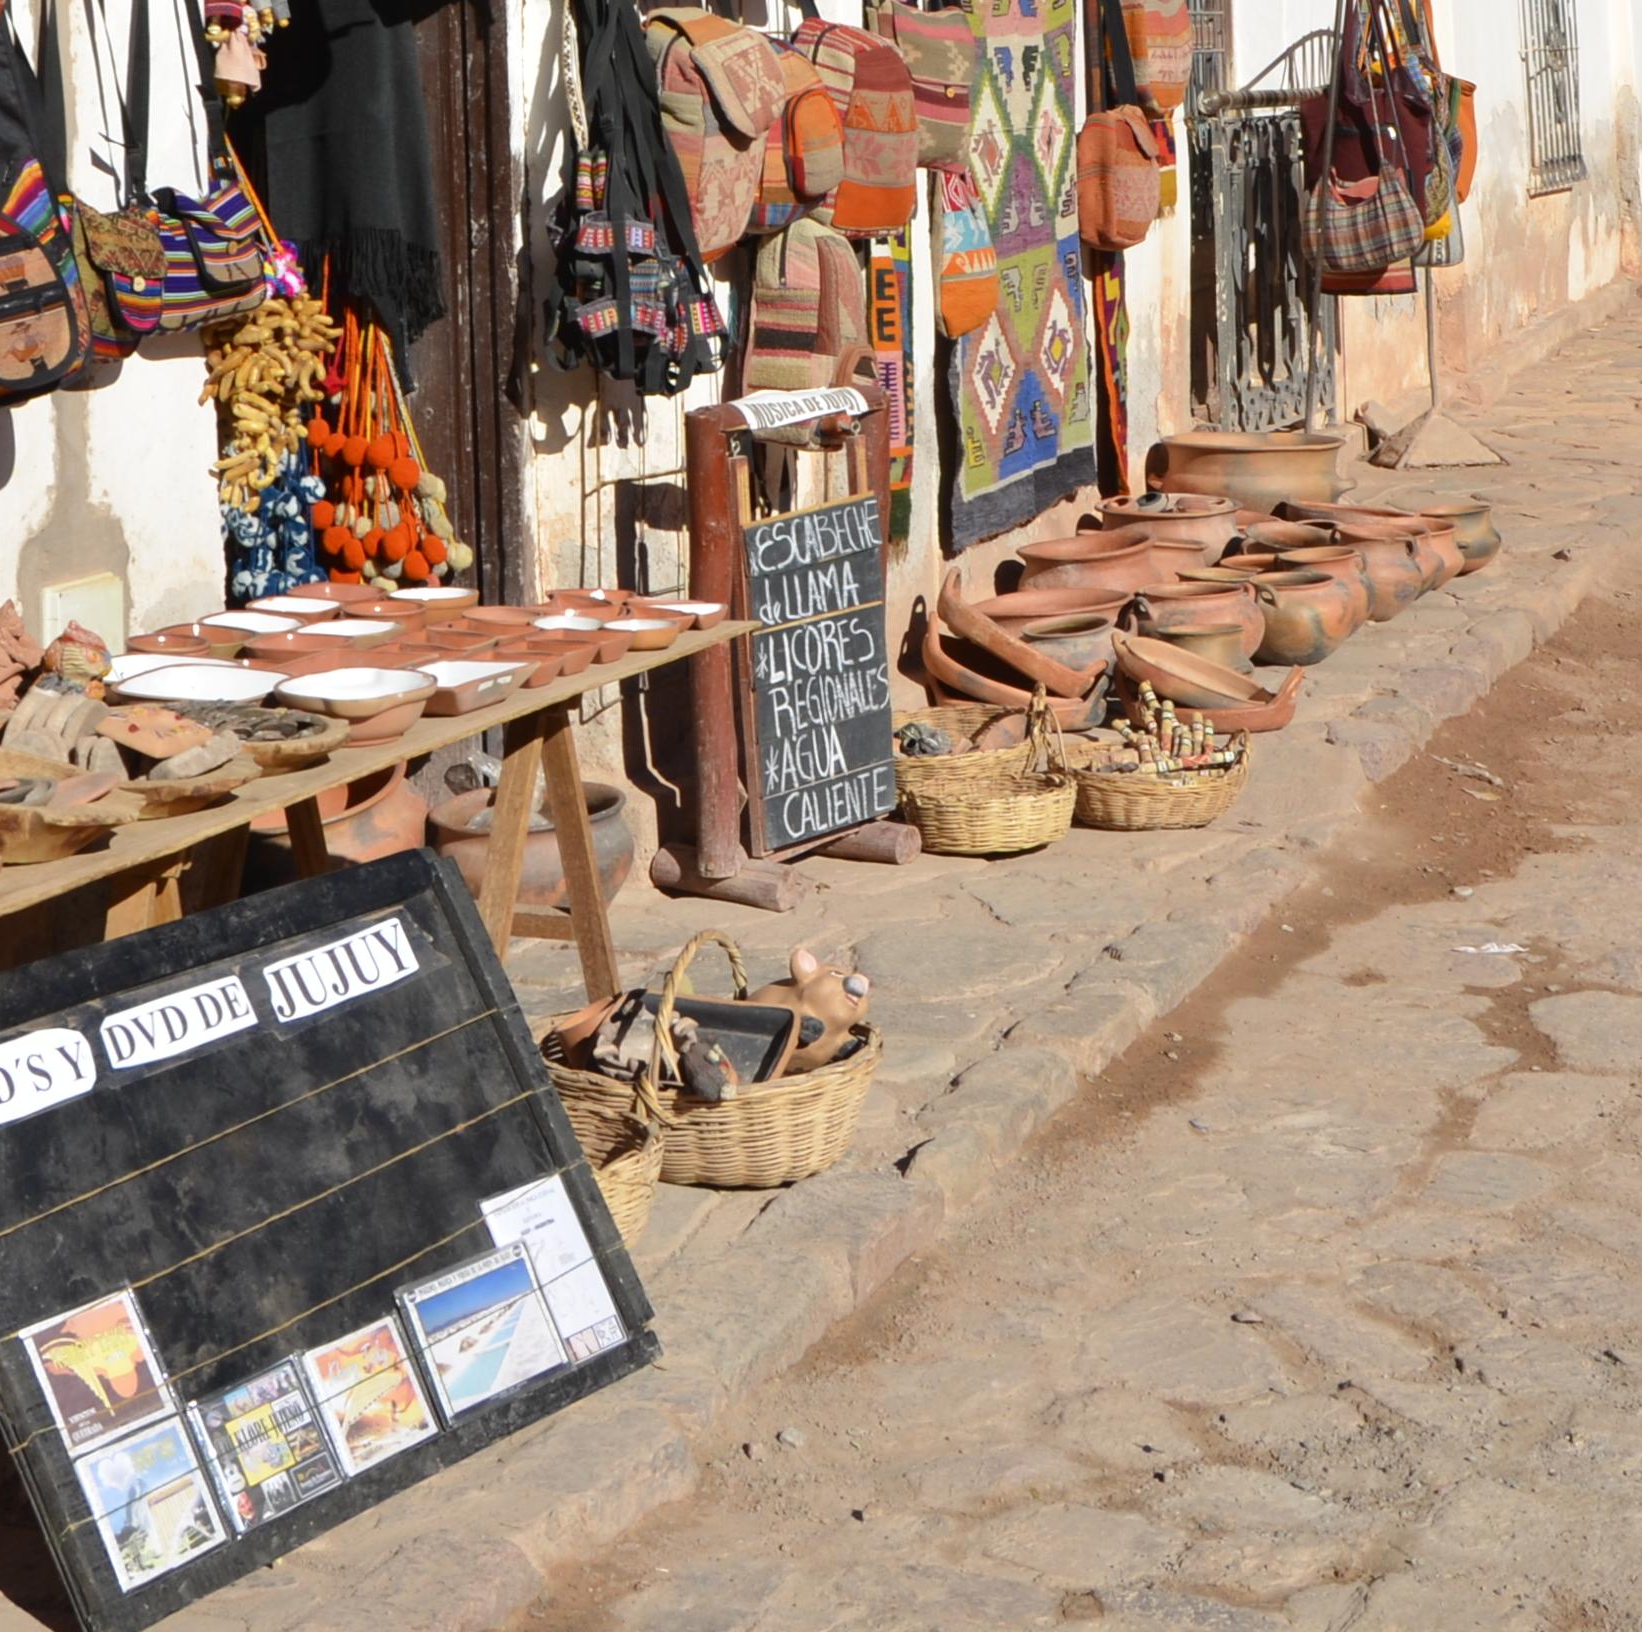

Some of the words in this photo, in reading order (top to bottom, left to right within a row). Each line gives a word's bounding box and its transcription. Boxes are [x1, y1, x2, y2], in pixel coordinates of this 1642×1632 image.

[747, 396, 805, 429] MUSICA
[805, 393, 824, 412] DE
[755, 500, 883, 571] ESCABECHE
[759, 577, 782, 626] de
[782, 560, 860, 620] LLAMA
[768, 618, 875, 684] LICORES
[768, 662, 890, 739] REGIONALES
[780, 723, 849, 793] AGUA
[783, 767, 892, 838] CALIENTE
[55, 1040, 92, 1081] Y
[104, 1007, 188, 1063] DVD
[191, 981, 251, 1030] DE
[268, 923, 412, 1020] JUJUY
